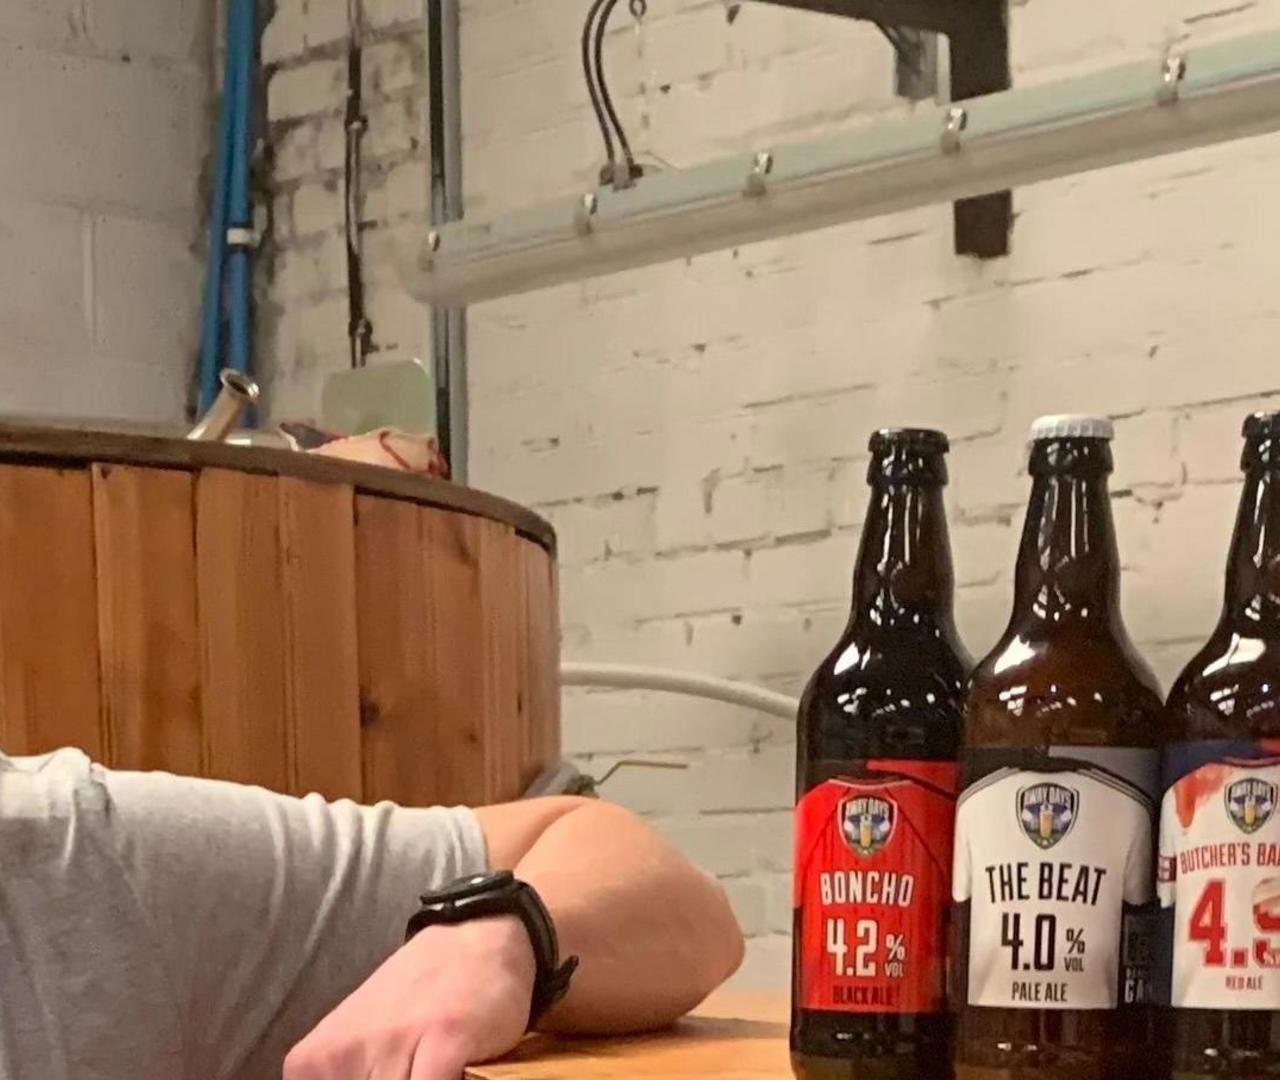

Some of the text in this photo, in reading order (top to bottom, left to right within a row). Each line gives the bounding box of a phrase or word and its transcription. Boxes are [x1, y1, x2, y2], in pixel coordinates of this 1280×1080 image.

[1180, 843, 1250, 875] BUTCHER'S
[820, 870, 914, 908] BONCHO
[985, 862, 1107, 906] THE BEAT
[826, 918, 905, 977] 4.2 %
[1001, 912, 1057, 972] 4.0
[1065, 928, 1086, 954] %
[884, 961, 904, 977] VOL
[1064, 956, 1084, 973] VOL
[1012, 982, 1068, 1003] PALE ALE
[1226, 975, 1263, 990] RED ALE
